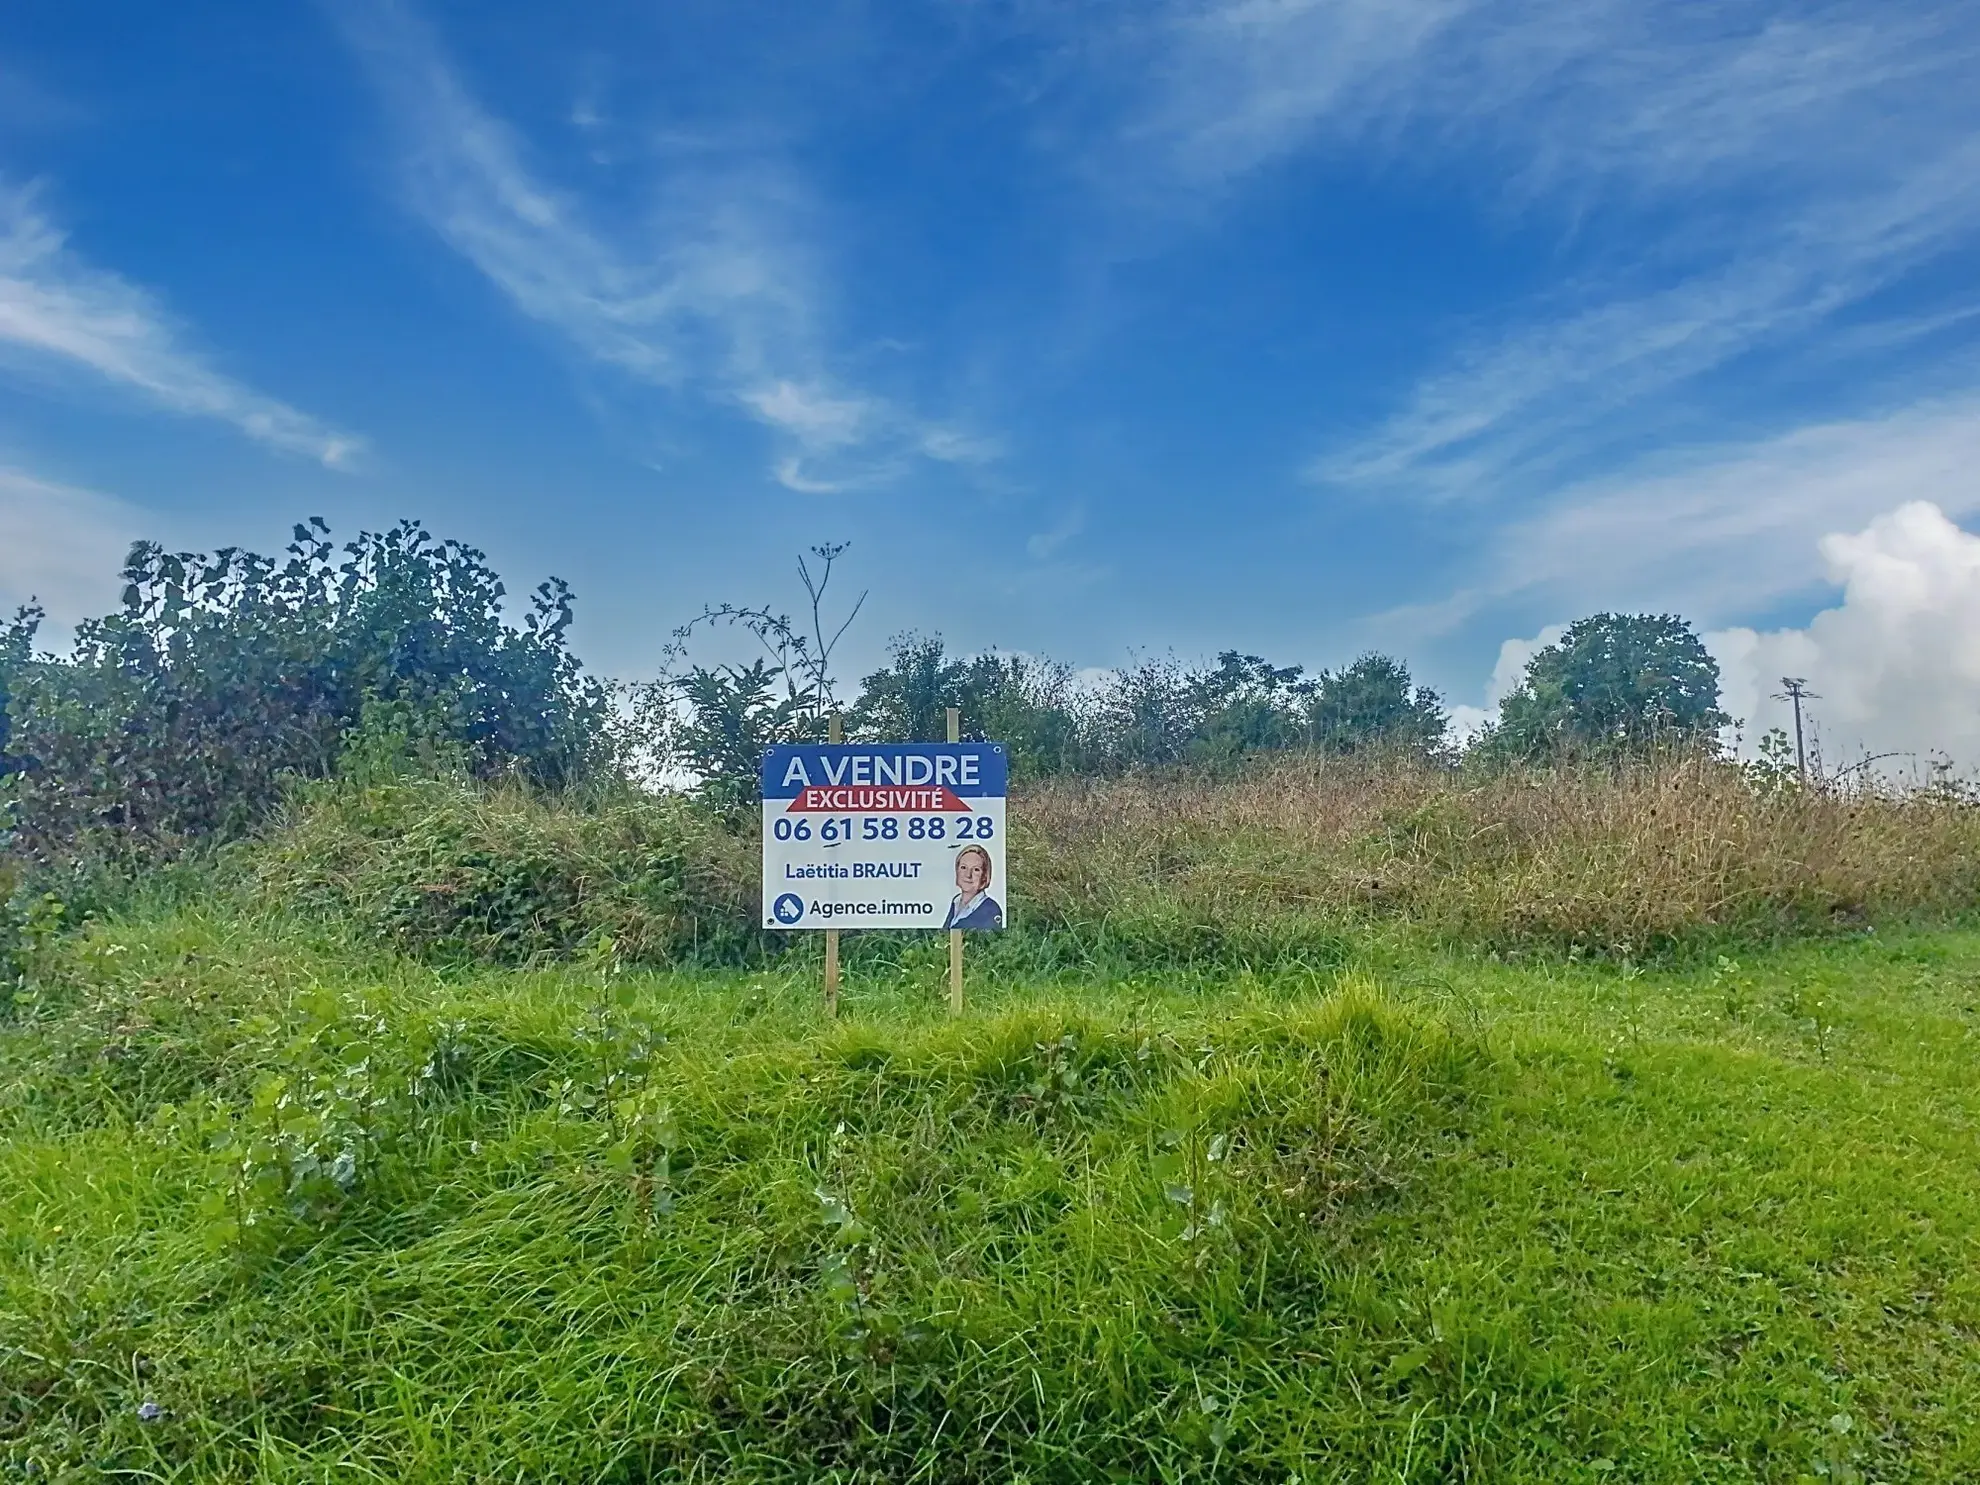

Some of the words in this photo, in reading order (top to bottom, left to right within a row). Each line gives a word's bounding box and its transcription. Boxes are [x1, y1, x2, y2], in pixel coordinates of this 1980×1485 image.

[782, 756, 811, 787] A
[820, 755, 980, 786] VENDRE
[806, 788, 943, 809] EXCLUSIVITÉ
[773, 818, 812, 841] 06
[820, 818, 851, 841] 61
[862, 817, 899, 840] 58
[908, 817, 946, 840] 88
[955, 816, 994, 840] 28
[785, 863, 849, 879] Laëtitia
[852, 863, 922, 879] BRAULT
[809, 900, 933, 918] Agence.immo
